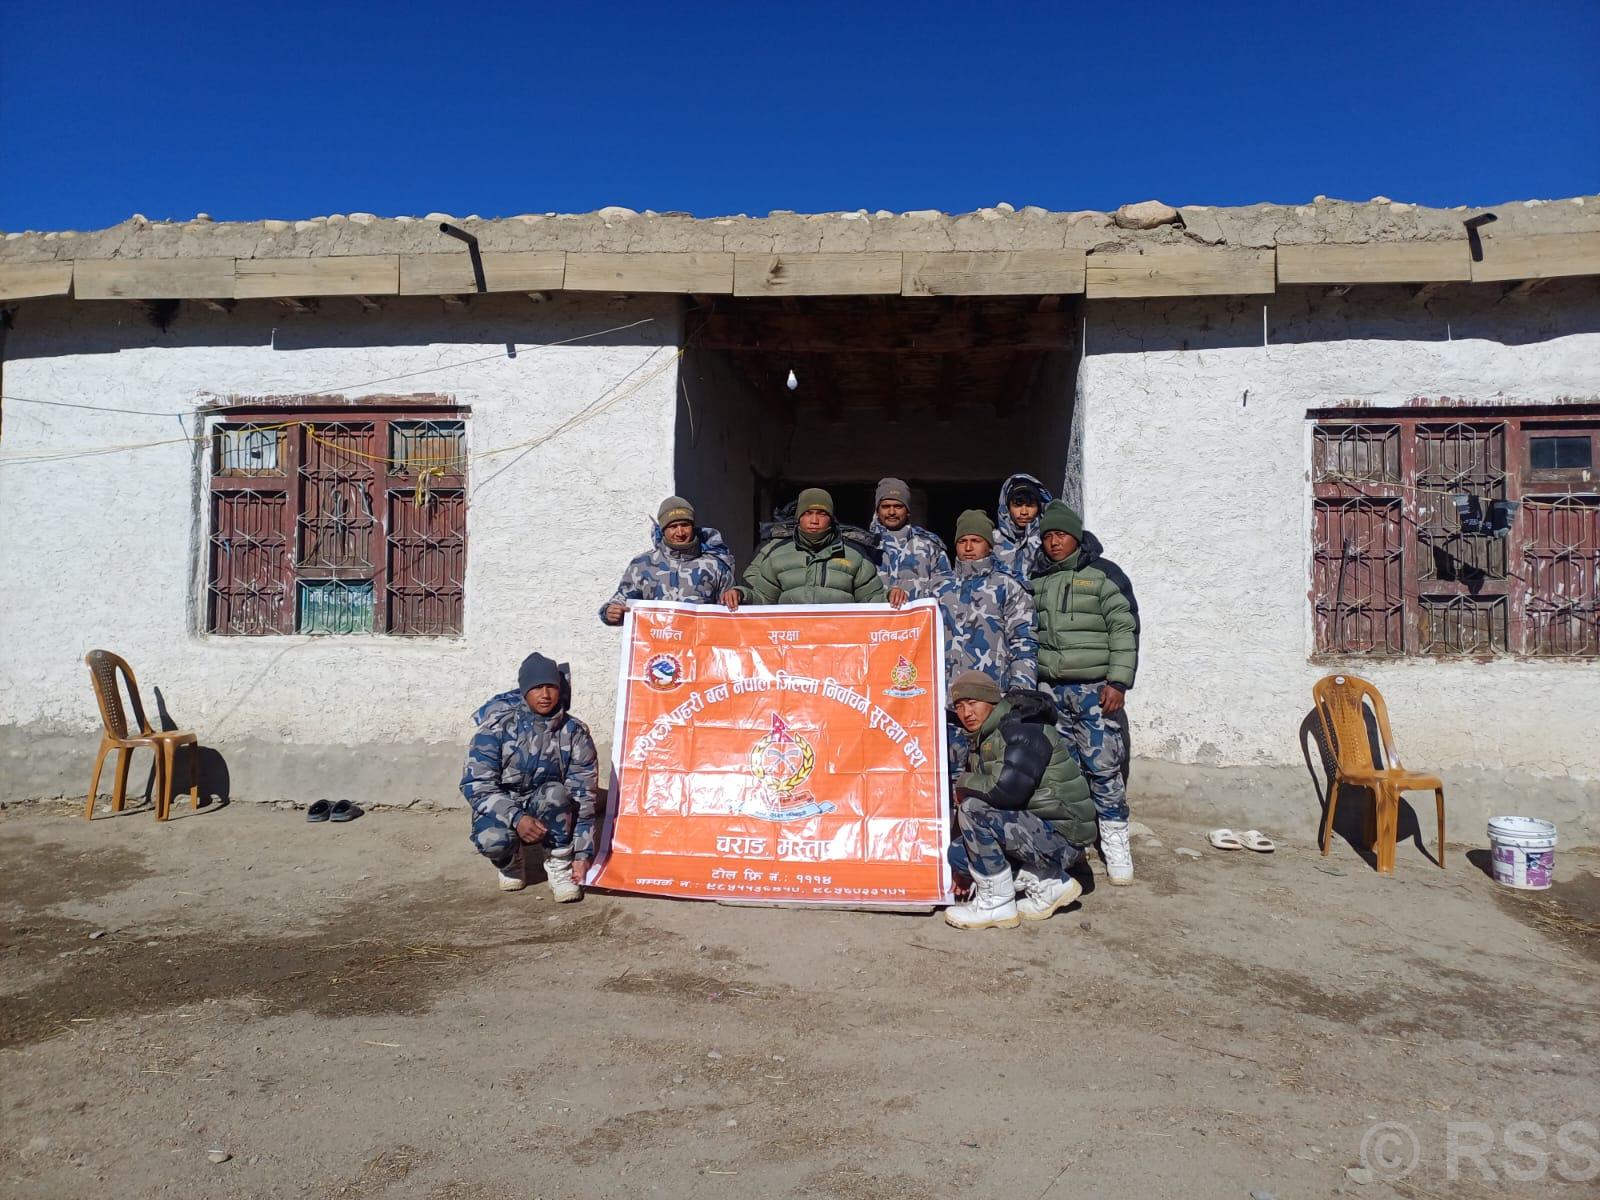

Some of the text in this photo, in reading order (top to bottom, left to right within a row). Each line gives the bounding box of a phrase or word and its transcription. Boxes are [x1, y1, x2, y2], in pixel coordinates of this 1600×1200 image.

[767, 630, 801, 645] सुरक्षा
[869, 626, 920, 643] प्रतिबद्धता
[703, 682, 730, 704] बल
[775, 670, 820, 695] जिल्ला
[869, 704, 909, 744] सुरक्षा
[711, 867, 738, 880] टोल
[743, 868, 763, 881] फ्रि
[796, 874, 833, 885] १११४
